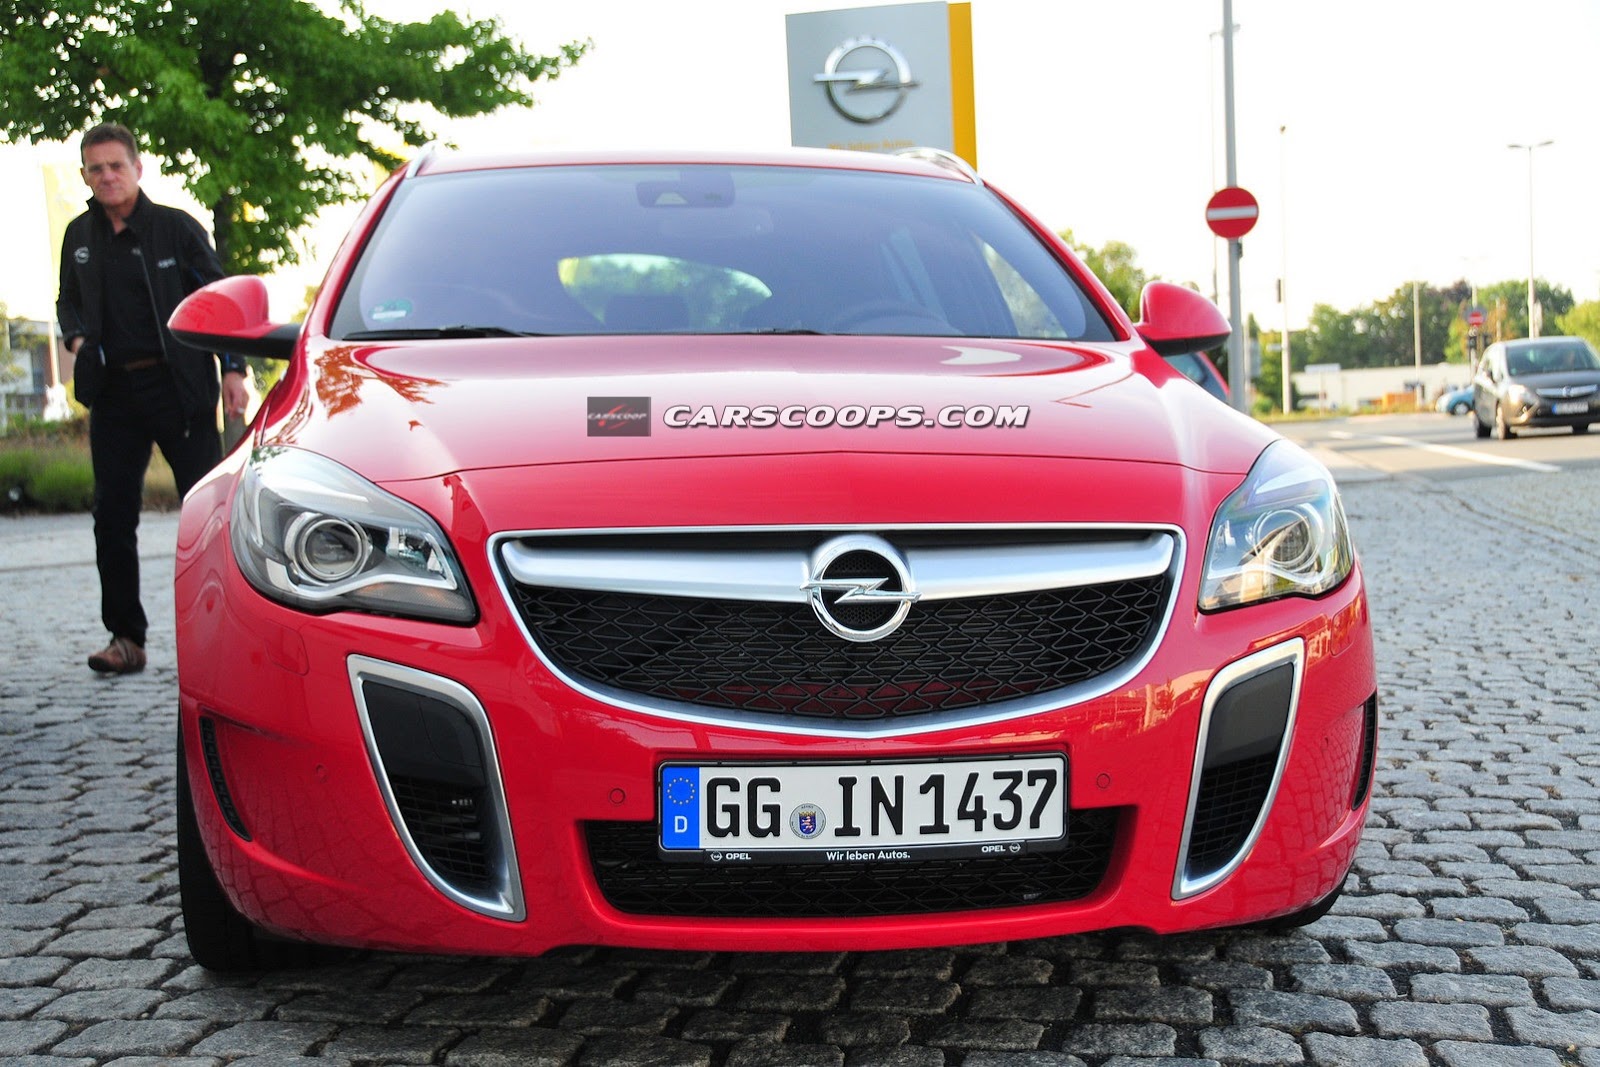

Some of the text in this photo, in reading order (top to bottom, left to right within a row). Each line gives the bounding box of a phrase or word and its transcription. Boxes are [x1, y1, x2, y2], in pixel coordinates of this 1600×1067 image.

[706, 768, 1058, 838] GG IN 1437
[674, 815, 688, 834] D
[826, 849, 911, 861] Wir leben Autos.
[981, 845, 1006, 854] OPEL
[725, 852, 752, 861] OPEL
